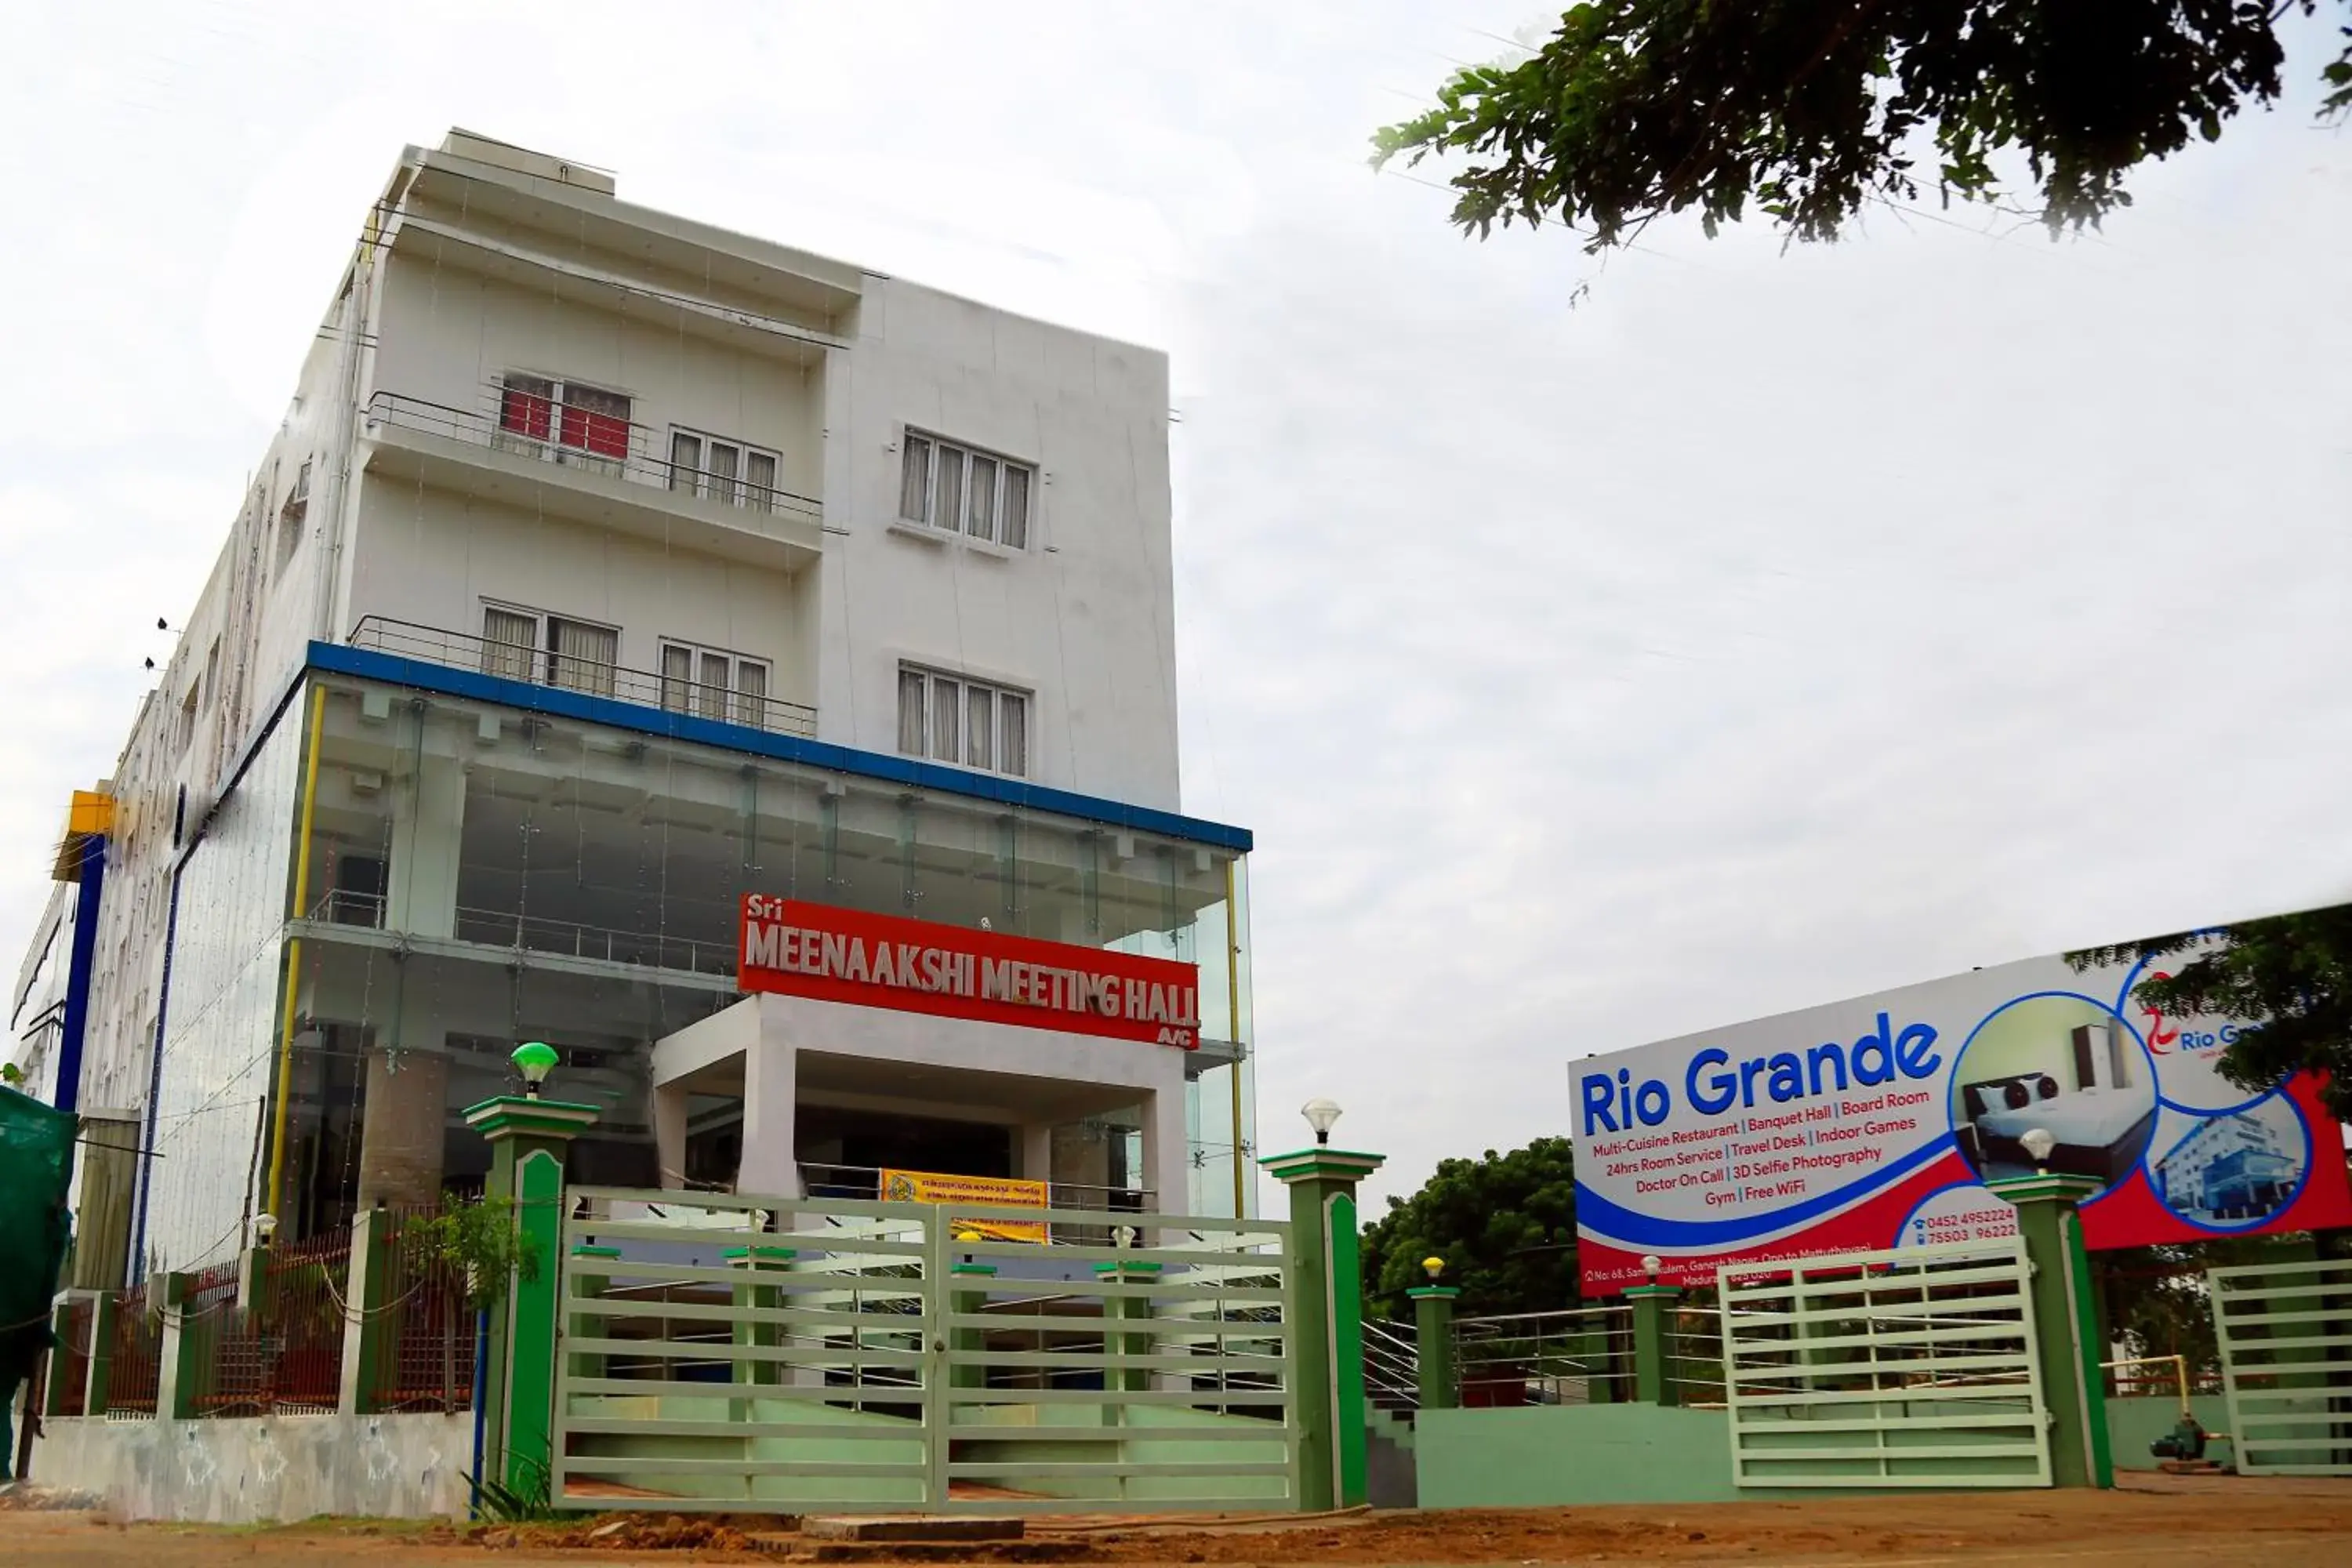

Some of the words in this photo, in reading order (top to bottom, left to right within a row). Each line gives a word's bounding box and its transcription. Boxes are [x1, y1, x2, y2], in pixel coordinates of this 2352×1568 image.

[747, 894, 782, 920] Sri
[745, 921, 977, 997] MEENAAKSHI
[980, 956, 1121, 1017] MEETING
[1124, 978, 1202, 1029] HALL
[1157, 1027, 1192, 1047] A/C
[2180, 1030, 2216, 1051] Rio
[1581, 1067, 1671, 1136] Rio
[1686, 1011, 1943, 1116] Grande
[1592, 1135, 1670, 1158] Multi-Cuisine
[1671, 1123, 1739, 1144] Restaurant
[1748, 1111, 1803, 1132] Banquet
[1806, 1105, 1832, 1121] Hall
[1842, 1095, 1884, 1116] Board
[1886, 1091, 1930, 1107] Room
[1606, 1162, 1639, 1177] 24hrs
[1641, 1156, 1675, 1172] Room
[1677, 1148, 1723, 1165] Service
[1731, 1138, 1770, 1156] Travel
[1773, 1134, 1807, 1151] Desk
[1816, 1127, 1861, 1144] Indoor
[1864, 1117, 1917, 1135] Games
[1636, 1176, 1678, 1193] Doctor
[1679, 1173, 1698, 1187] On
[1700, 1168, 1724, 1183] Call
[1733, 1164, 1751, 1179] 3D
[1754, 1158, 1790, 1176] Selfie
[1792, 1146, 1882, 1171] Photography
[1705, 1191, 1737, 1208] Gym
[1745, 1185, 1775, 1200] Free
[1776, 1179, 1806, 1196] WiFi
[1926, 1214, 1958, 1229] 0452
